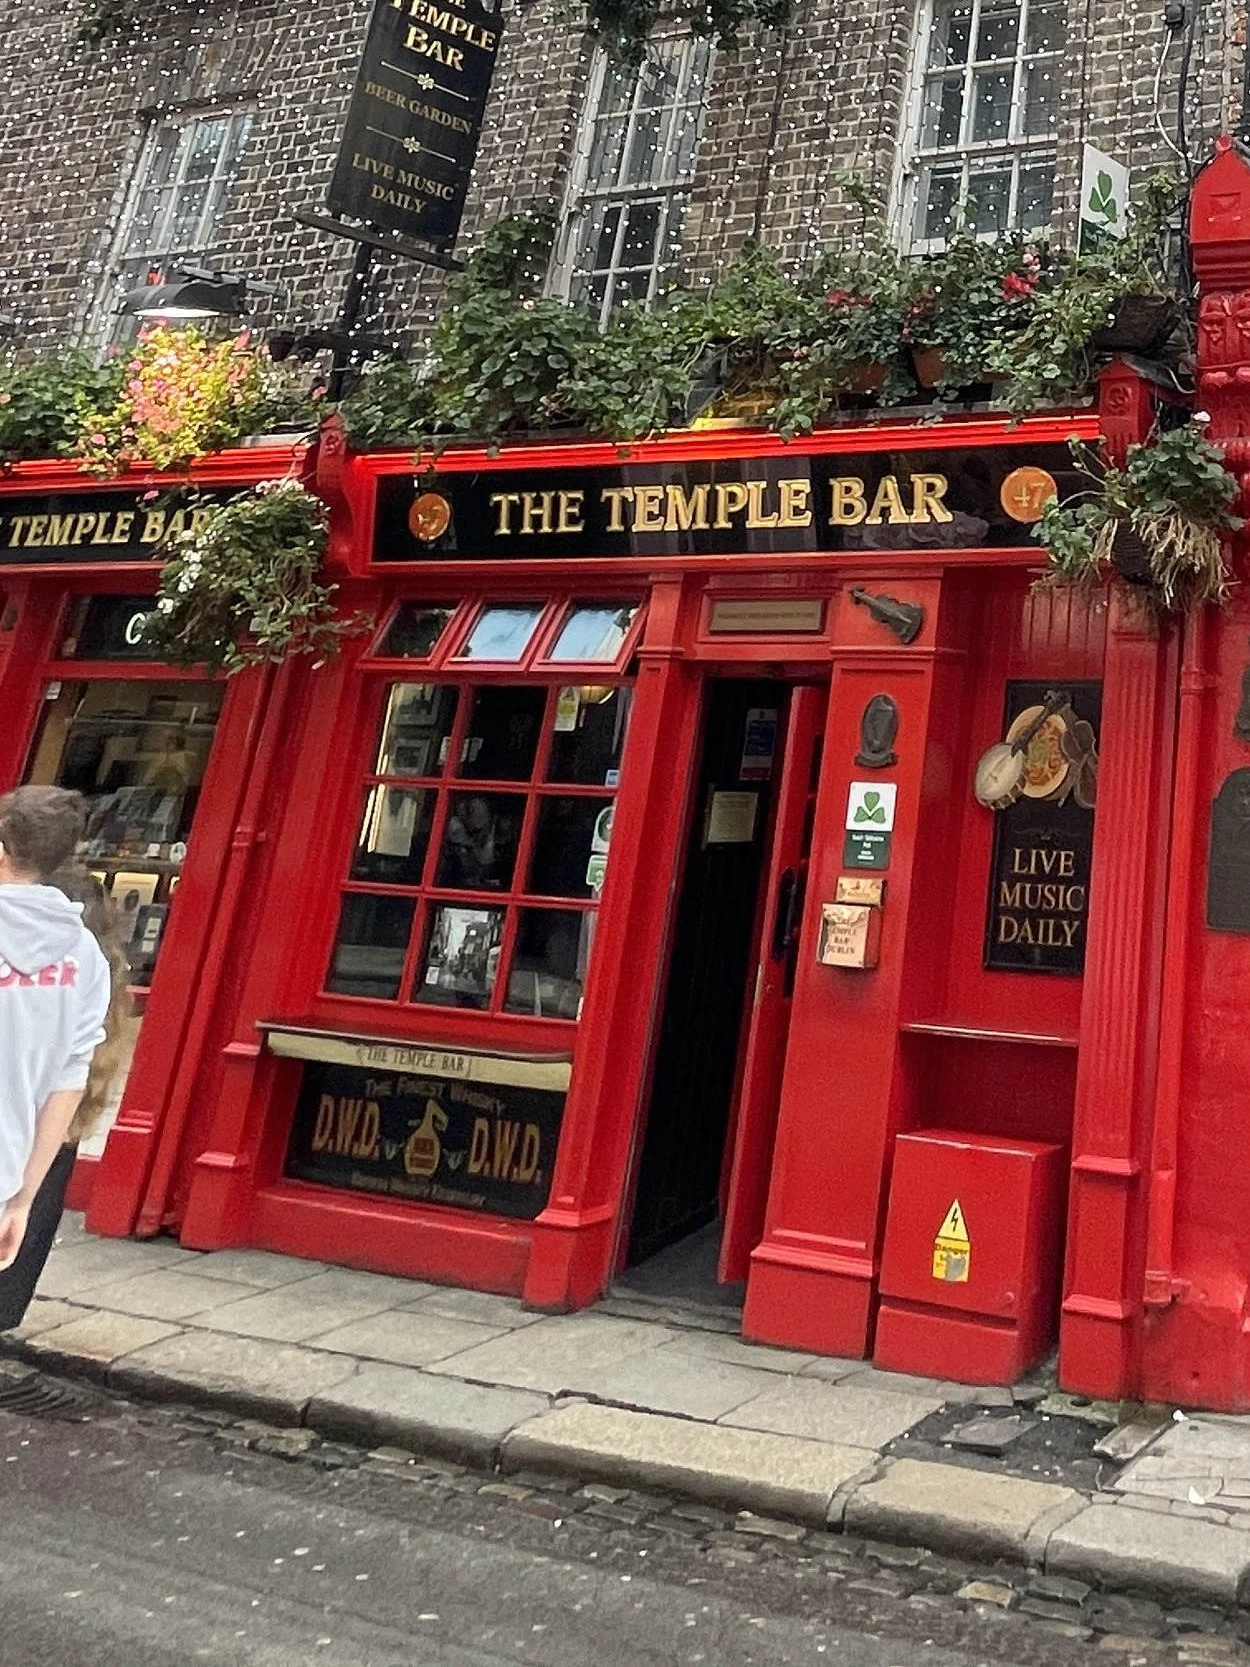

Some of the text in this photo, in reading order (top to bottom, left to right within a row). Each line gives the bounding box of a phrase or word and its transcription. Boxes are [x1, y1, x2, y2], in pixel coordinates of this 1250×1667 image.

[403, 22, 464, 72] BAR
[365, 81, 473, 135] BEER GARDEN
[352, 153, 454, 201] LIVE MUSIC
[370, 185, 427, 214] DAILY
[490, 473, 953, 536] THE TEMPLE BAR
[8, 510, 136, 548] TEMPLE
[1012, 848, 1075, 876] LIVE
[999, 881, 1085, 912] MUSIC
[998, 915, 1080, 947] DAILY
[366, 1045, 465, 1072] THE TEMPLE BAR
